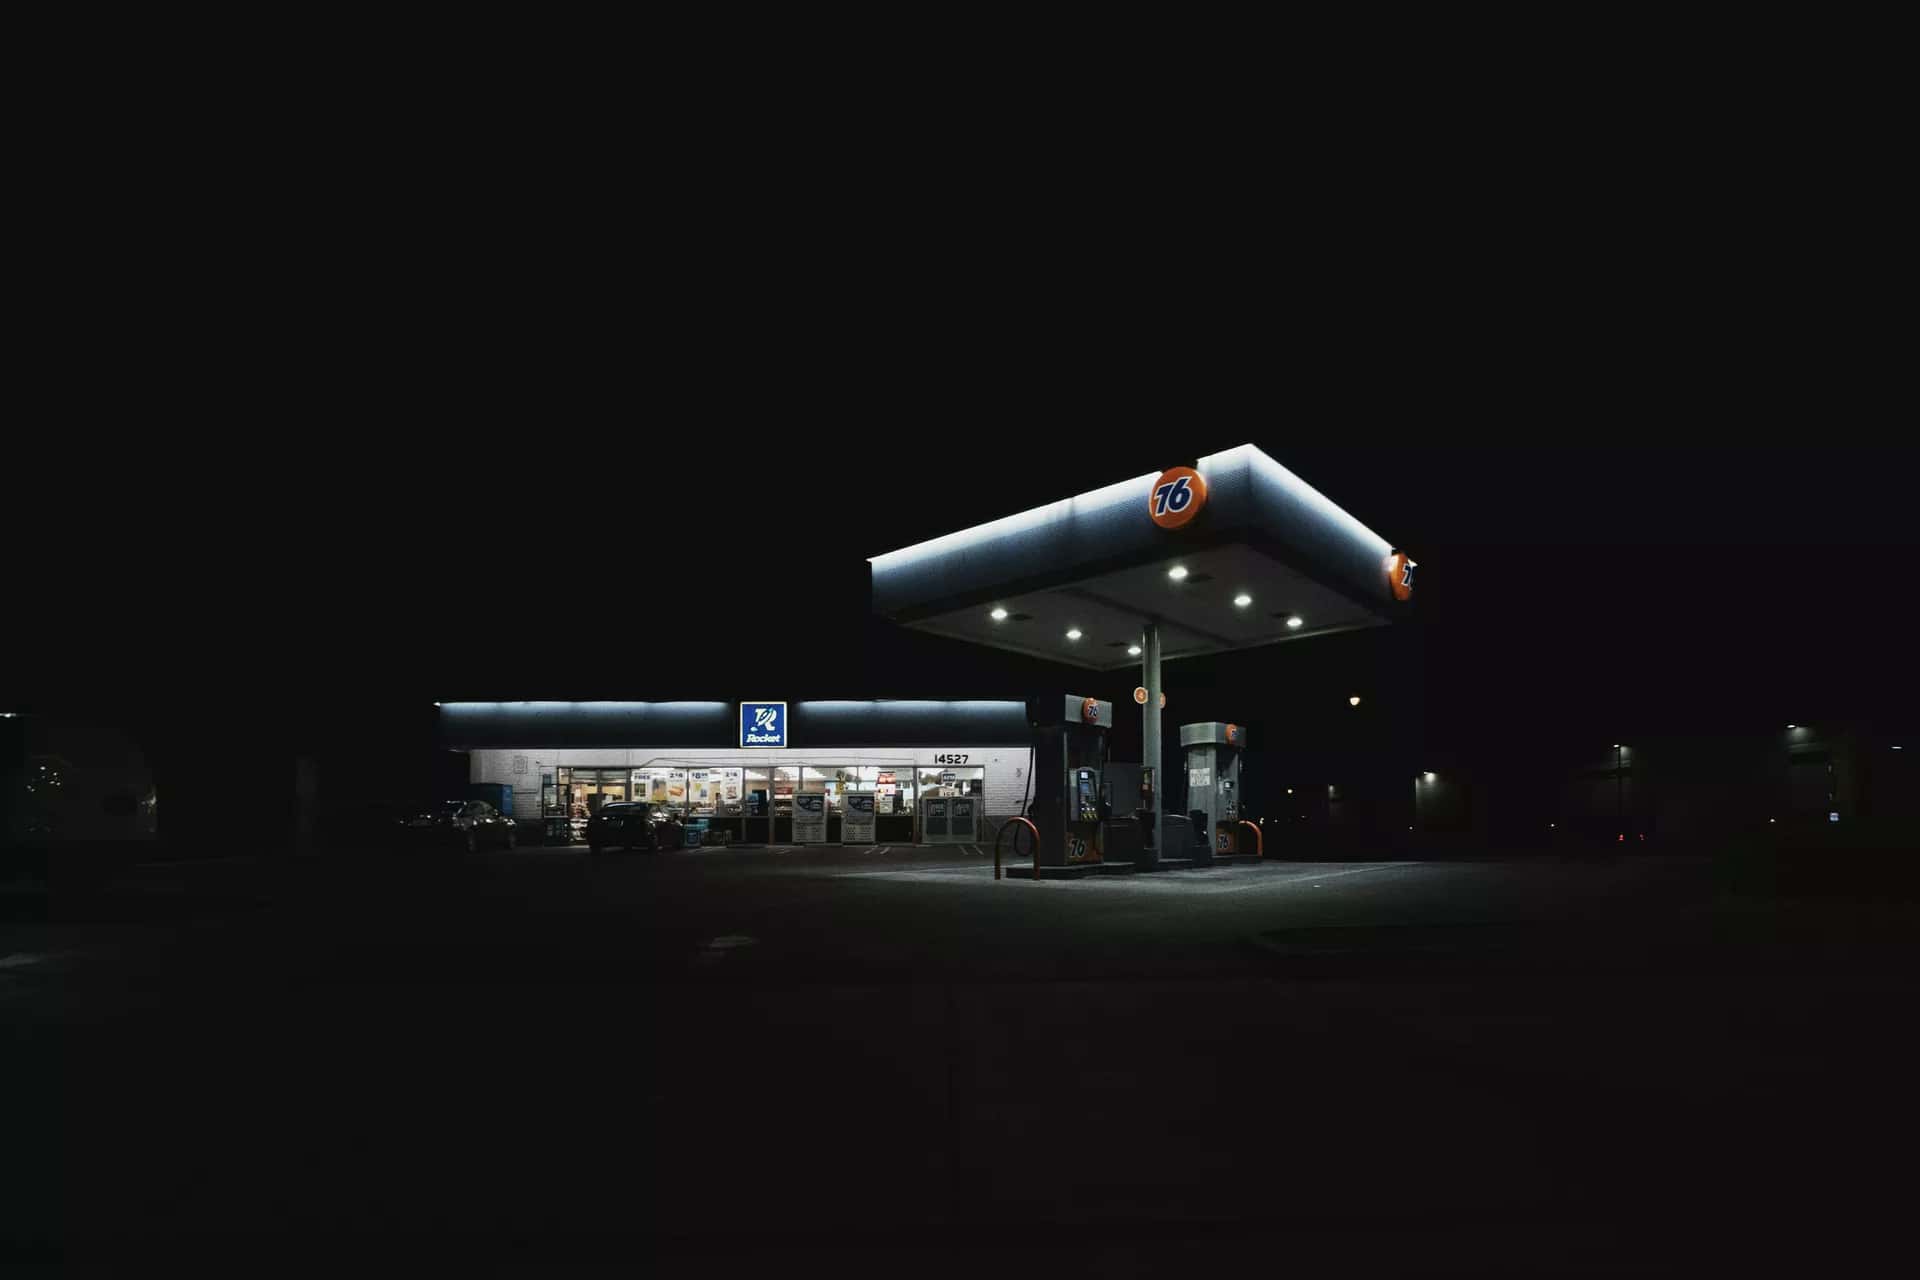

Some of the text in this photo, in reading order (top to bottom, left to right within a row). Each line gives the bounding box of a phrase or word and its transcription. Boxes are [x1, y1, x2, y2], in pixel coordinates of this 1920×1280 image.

[1154, 476, 1194, 517] 76
[1088, 706, 1098, 717] 76
[746, 733, 781, 743] Rocket
[934, 754, 969, 764] 14527
[1070, 838, 1086, 857] 76
[1217, 833, 1229, 849] 76
